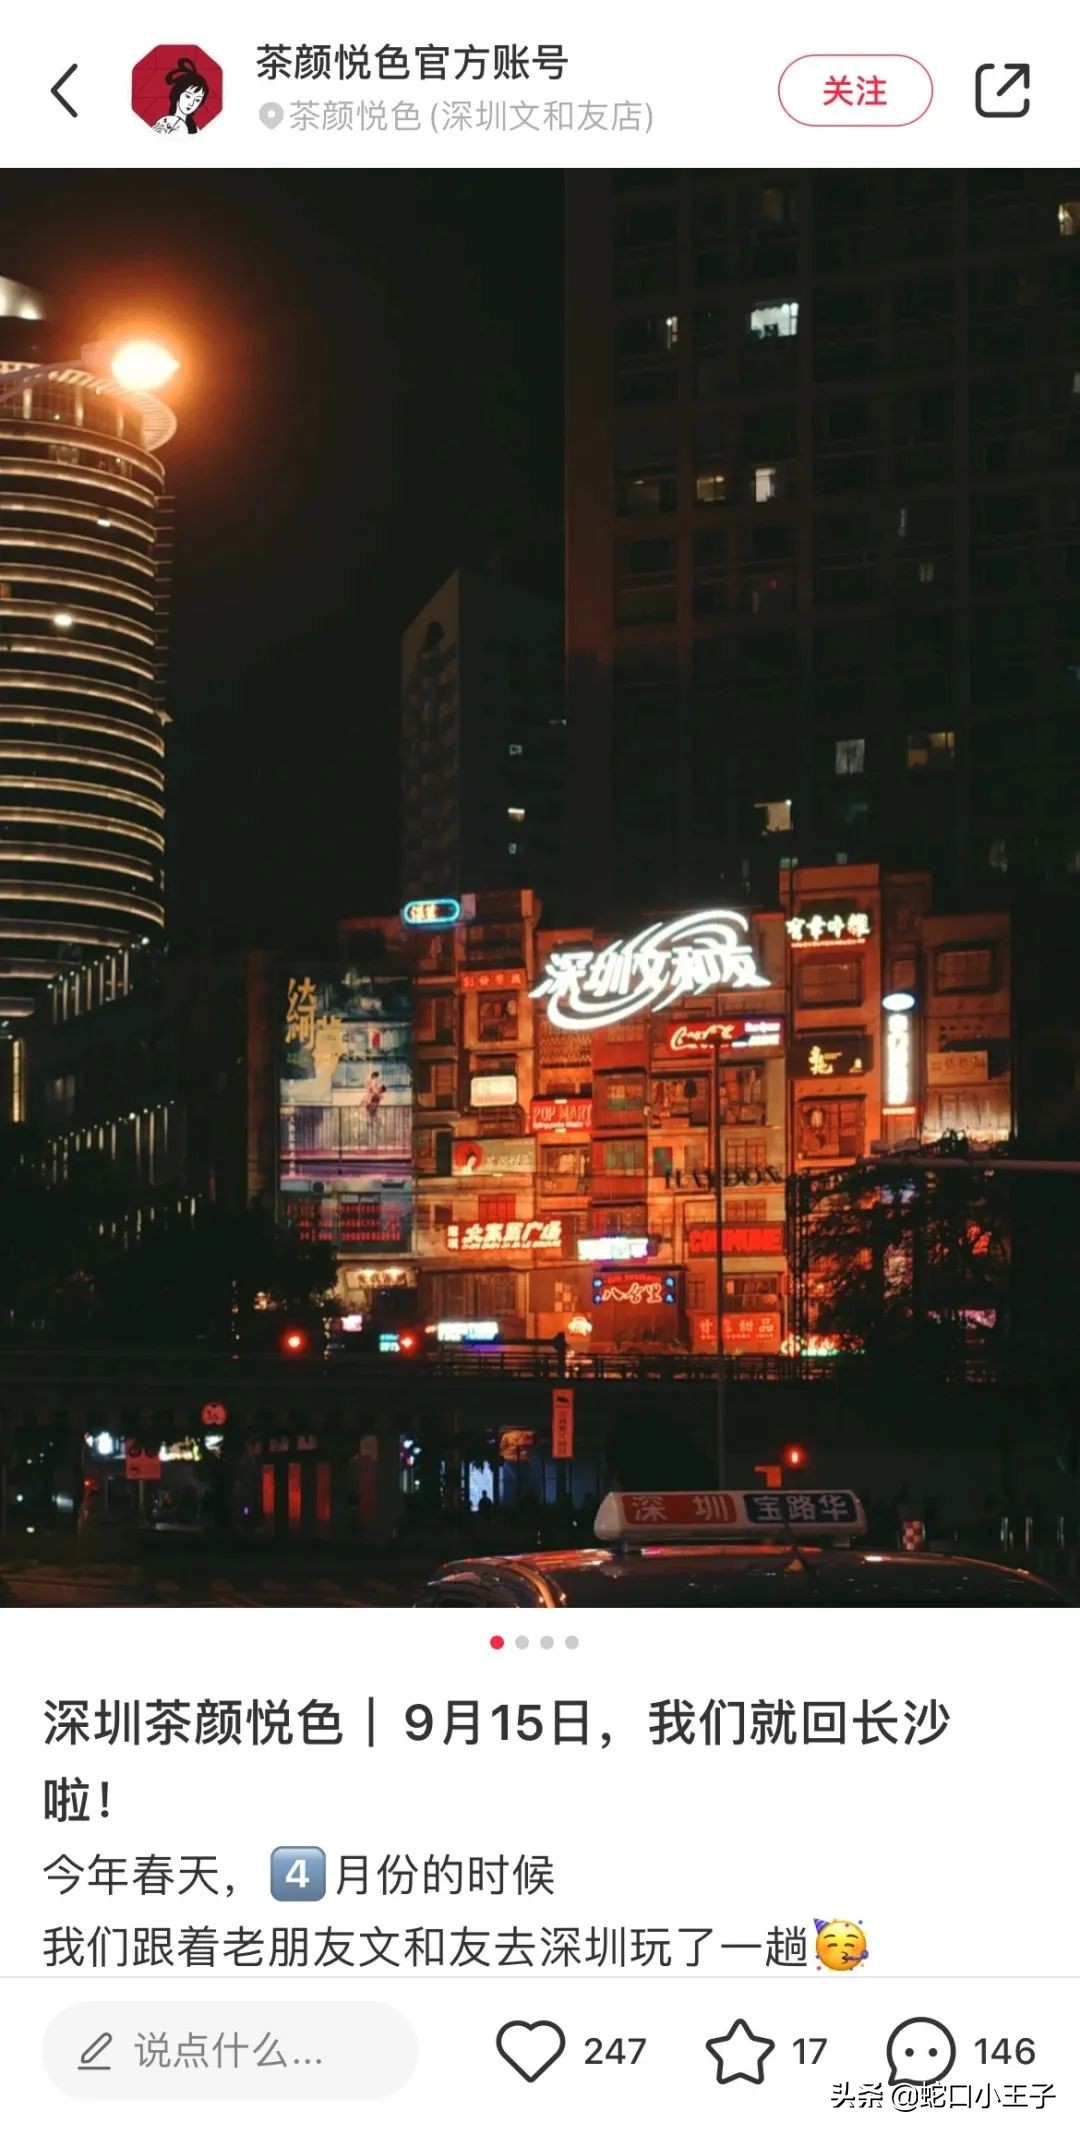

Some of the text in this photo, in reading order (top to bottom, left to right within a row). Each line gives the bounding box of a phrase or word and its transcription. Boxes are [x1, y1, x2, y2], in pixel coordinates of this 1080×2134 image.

[528, 910, 772, 1029] 深圳文和友
[632, 1494, 849, 1522] 深圳 宝路华
